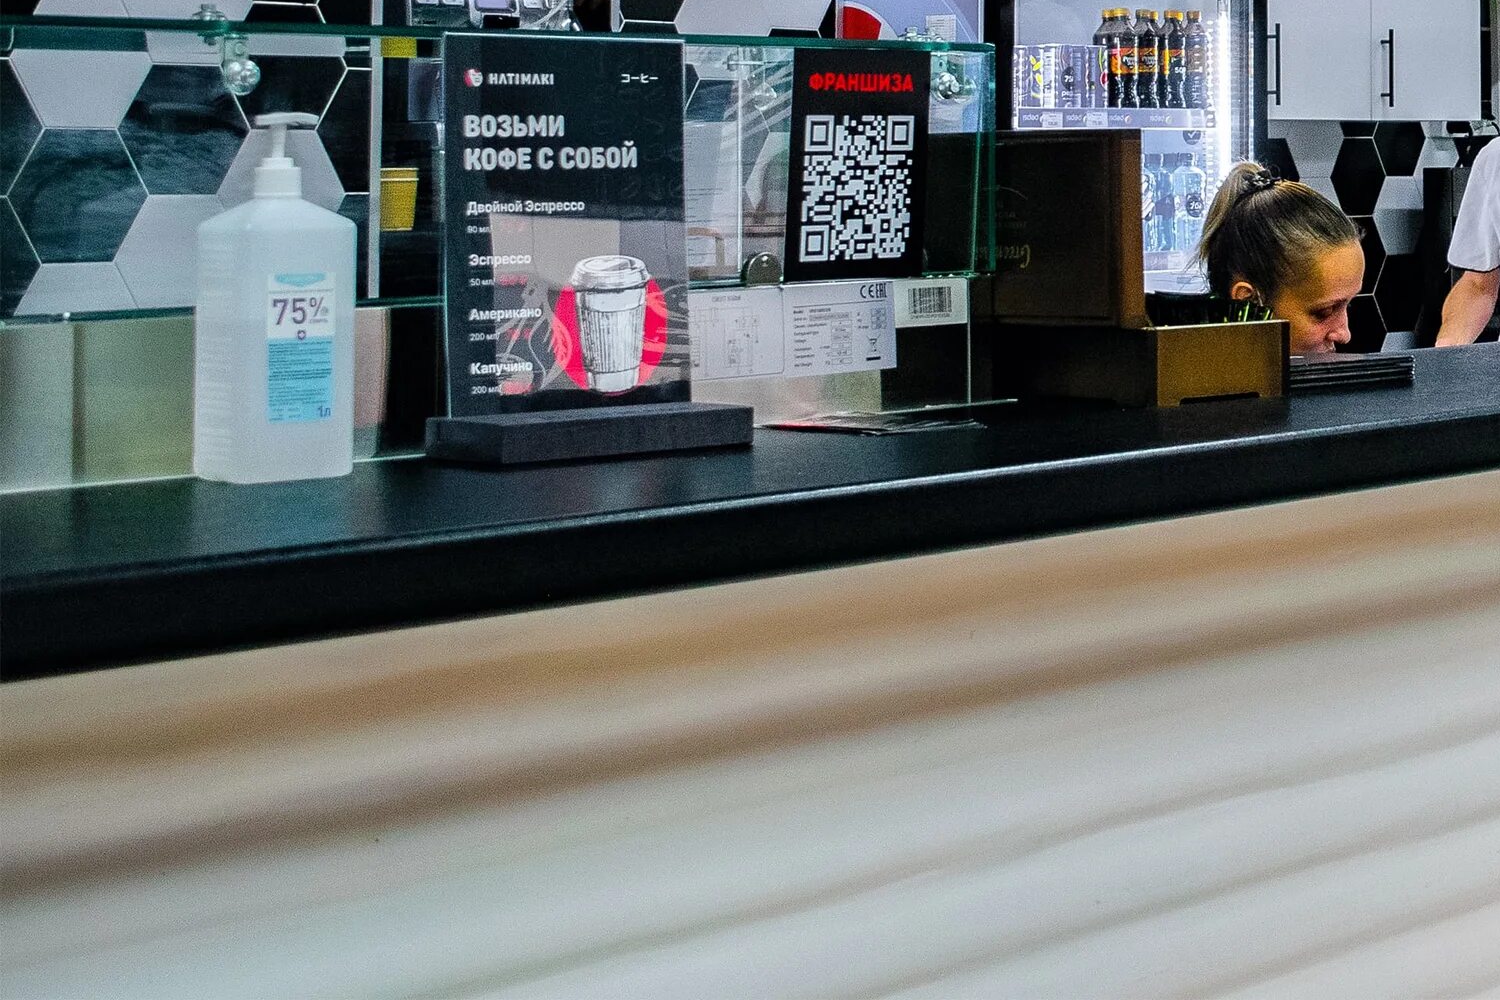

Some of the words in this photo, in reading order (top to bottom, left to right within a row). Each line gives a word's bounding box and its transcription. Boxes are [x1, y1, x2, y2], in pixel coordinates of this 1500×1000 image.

[488, 73, 554, 86] HATIMAKI
[621, 73, 659, 83] コーヒー
[809, 72, 914, 93] ФРАНШИЗА
[463, 114, 565, 138] ВОЗЬМИ
[463, 147, 532, 171] КОФЕ
[536, 147, 554, 170] С
[559, 140, 638, 169] СОБОЙ
[467, 199, 523, 216] Двойной
[525, 199, 586, 215] Эспрессо
[469, 254, 532, 267] Эспрессо
[273, 296, 325, 326] 75%
[469, 306, 542, 321] Американо
[469, 333, 486, 342] 200
[470, 361, 533, 376] Капучино
[471, 386, 488, 395] 200
